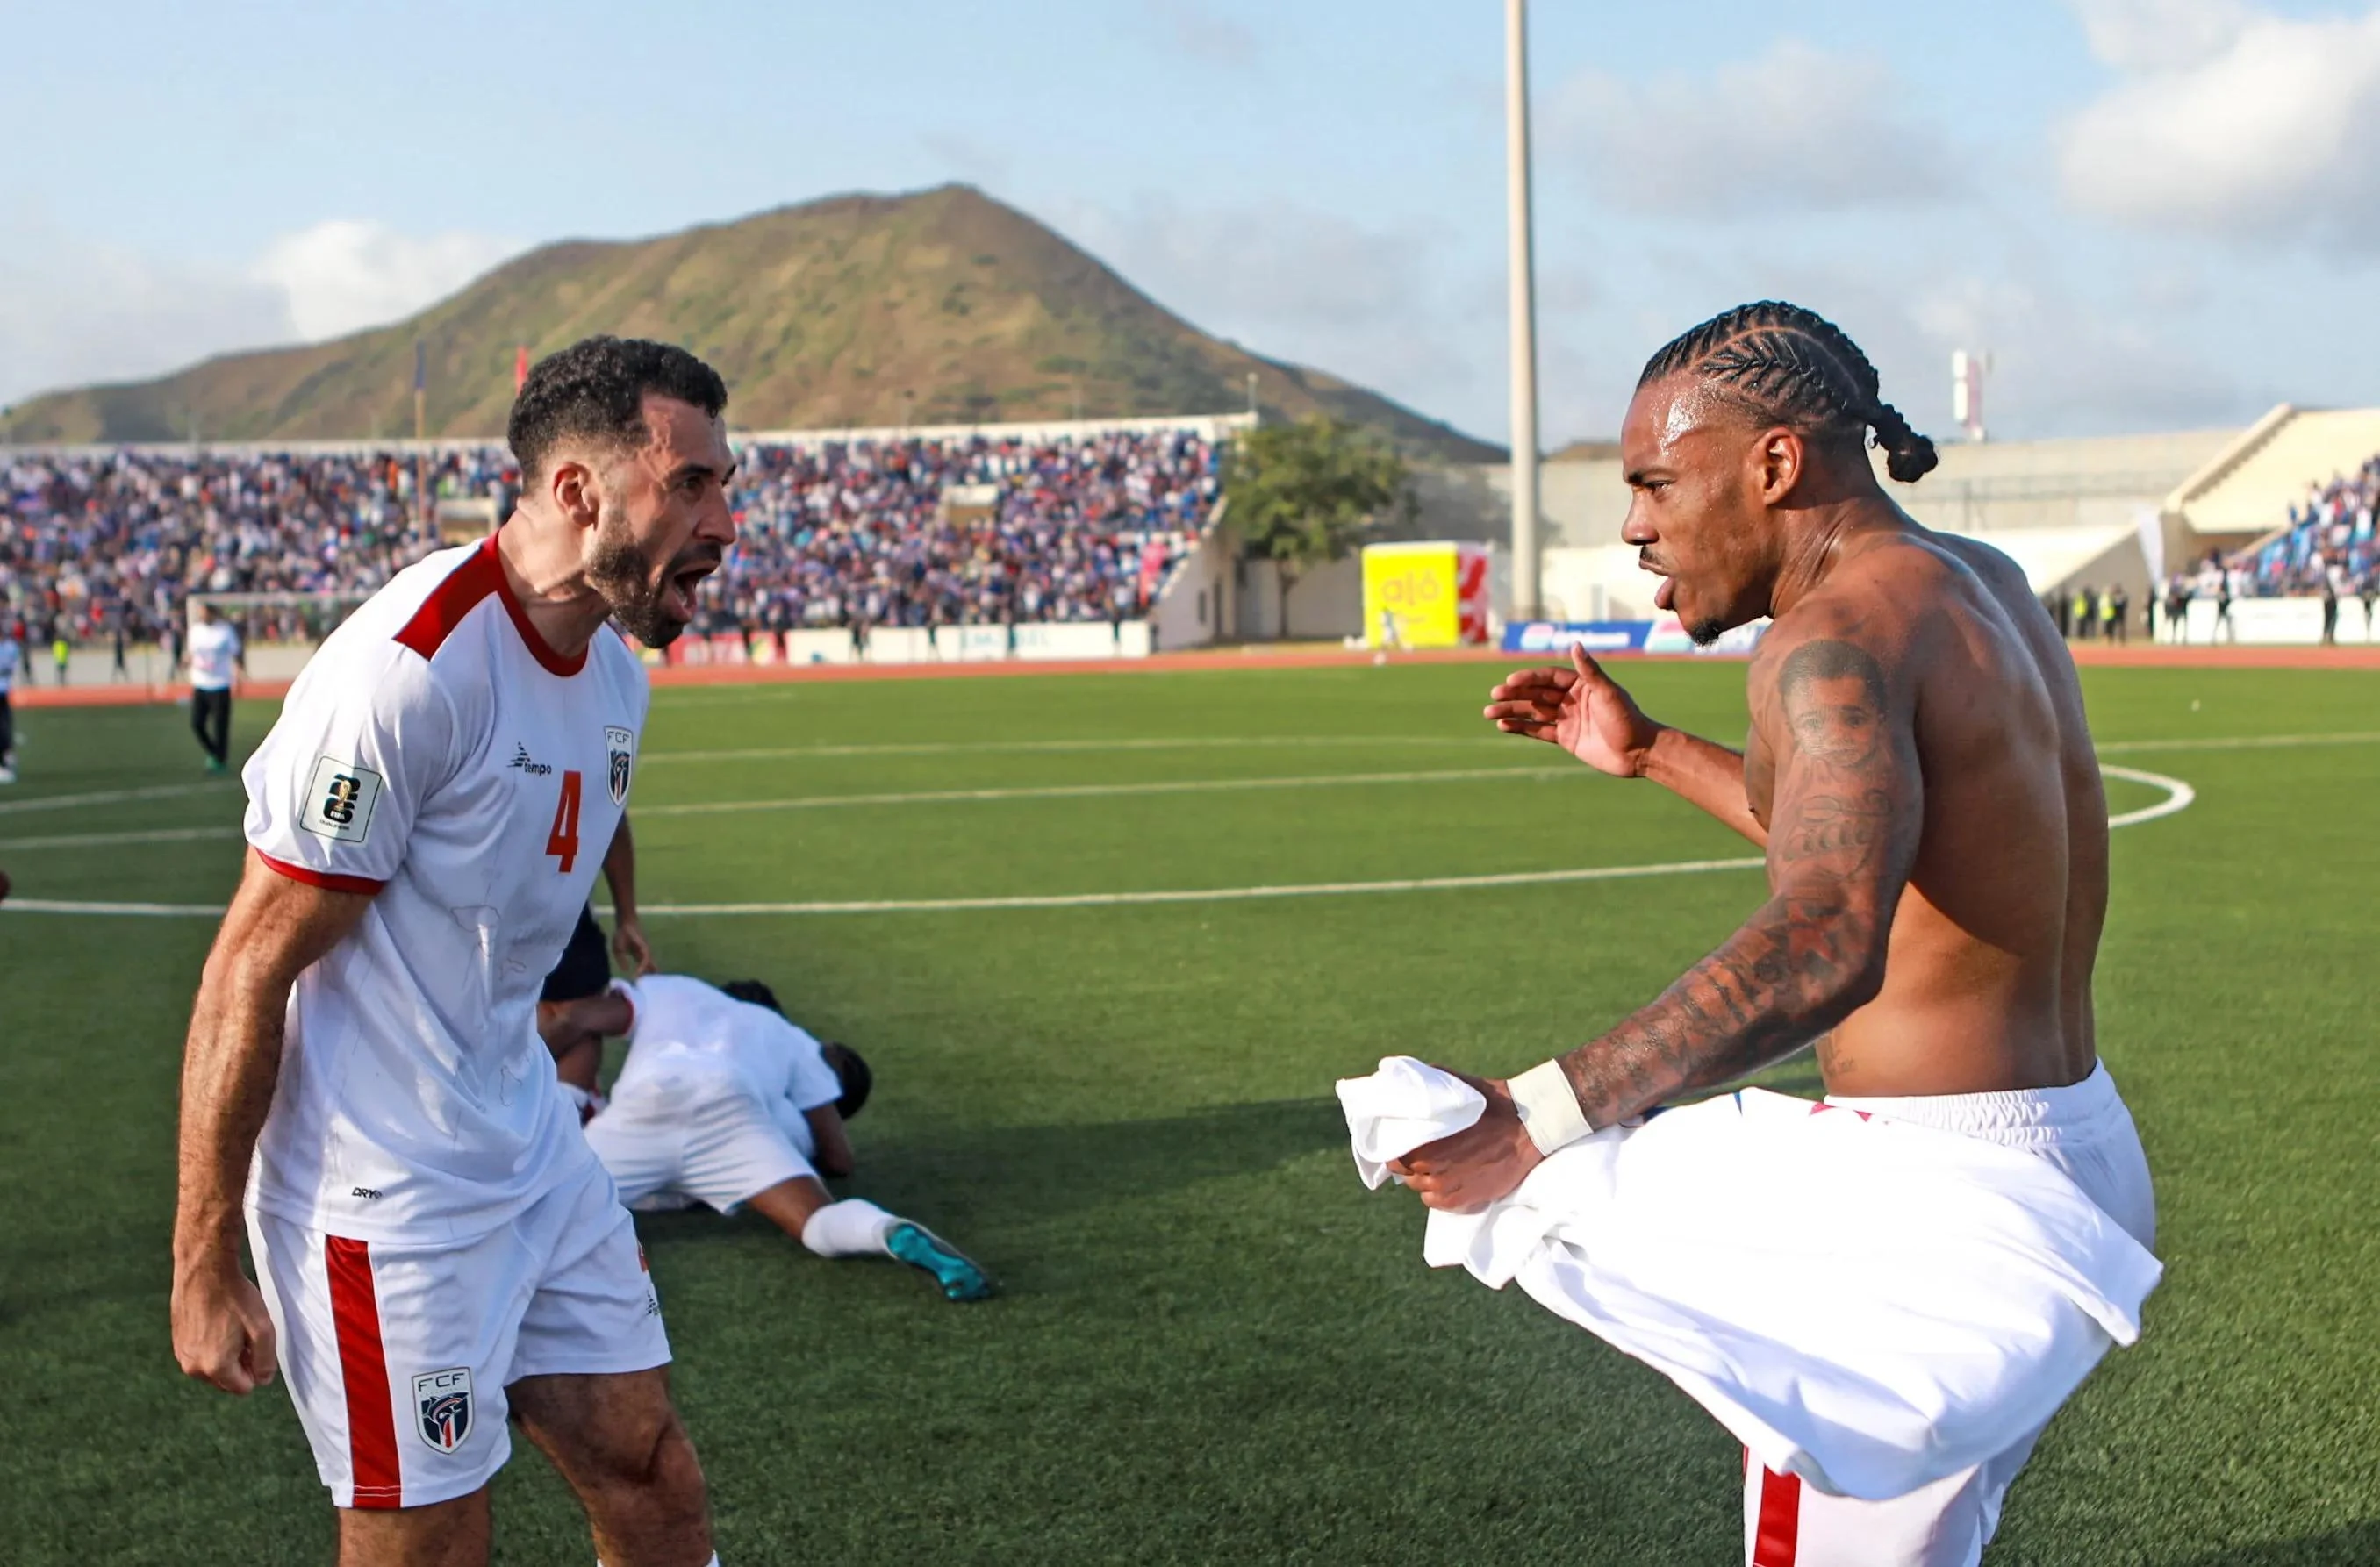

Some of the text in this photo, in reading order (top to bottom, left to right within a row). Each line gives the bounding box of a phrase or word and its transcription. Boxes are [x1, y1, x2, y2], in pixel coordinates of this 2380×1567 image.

[607, 731, 630, 744] FCF
[545, 770, 582, 873] 4
[418, 1372, 466, 1392] FCF
